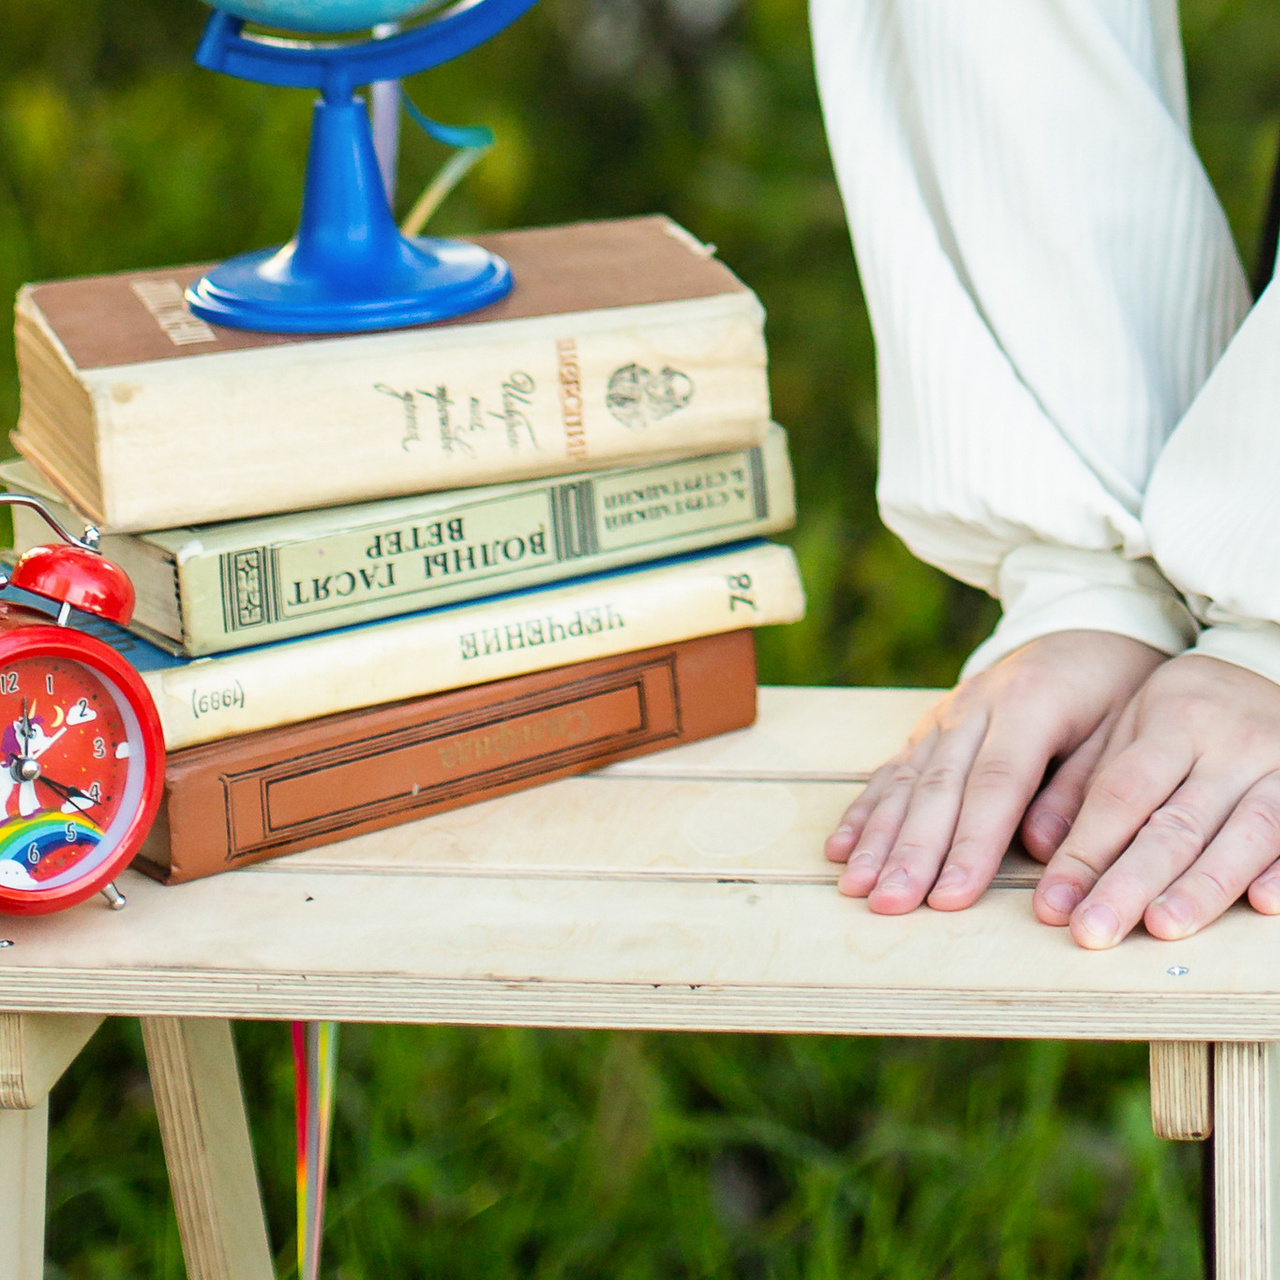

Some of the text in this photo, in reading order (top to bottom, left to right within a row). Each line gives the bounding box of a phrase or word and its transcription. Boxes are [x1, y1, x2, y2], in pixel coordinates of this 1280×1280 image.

[366, 517, 466, 560] ВЕТЕР
[287, 531, 548, 607] ВОЛНЫ ГАСЯТ
[726, 573, 757, 613] 78
[460, 604, 625, 660] ЧЕРЧЕНИЕ
[0, 673, 19, 694] 12
[46, 674, 54, 694] 1
[77, 698, 88, 718] 2
[191, 679, 245, 719] (1989)
[93, 738, 105, 758] 3
[88, 782, 101, 802] 4
[66, 822, 77, 842] 5
[28, 843, 40, 863] 6
